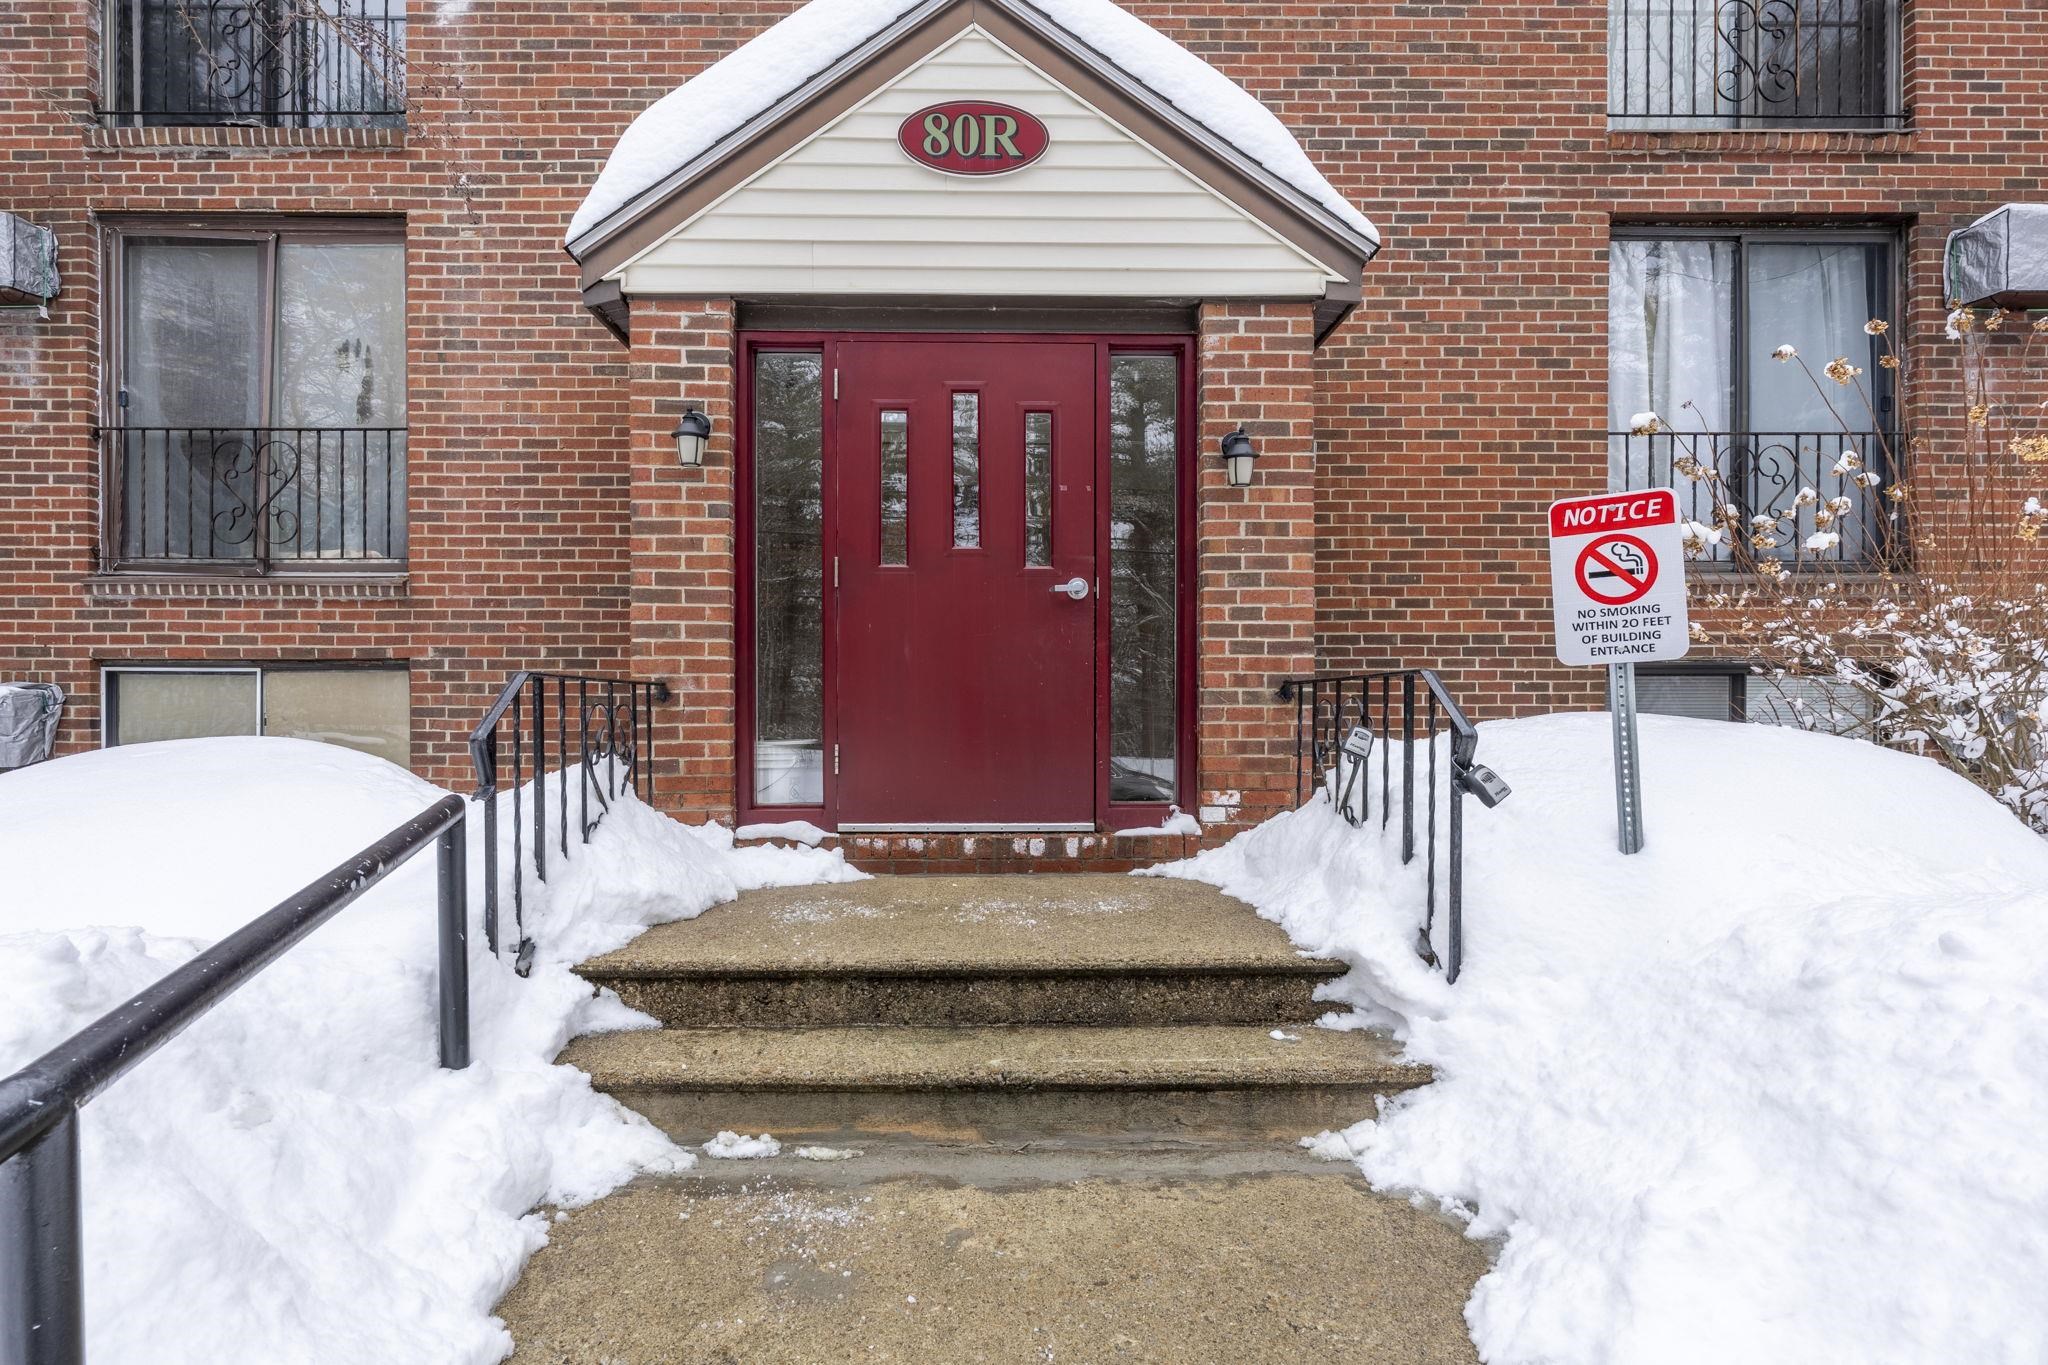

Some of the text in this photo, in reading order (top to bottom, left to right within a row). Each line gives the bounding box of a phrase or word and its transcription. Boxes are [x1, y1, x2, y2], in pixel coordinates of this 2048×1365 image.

[923, 113, 1024, 158] 80R
[1563, 498, 1662, 528] NOTICE
[1577, 603, 1661, 619] NO SMOKING
[1572, 615, 1671, 631] WITHIN 20 FEET
[1582, 630, 1661, 644] OF BUILDING
[1590, 643, 1656, 656] ENTRANCE
